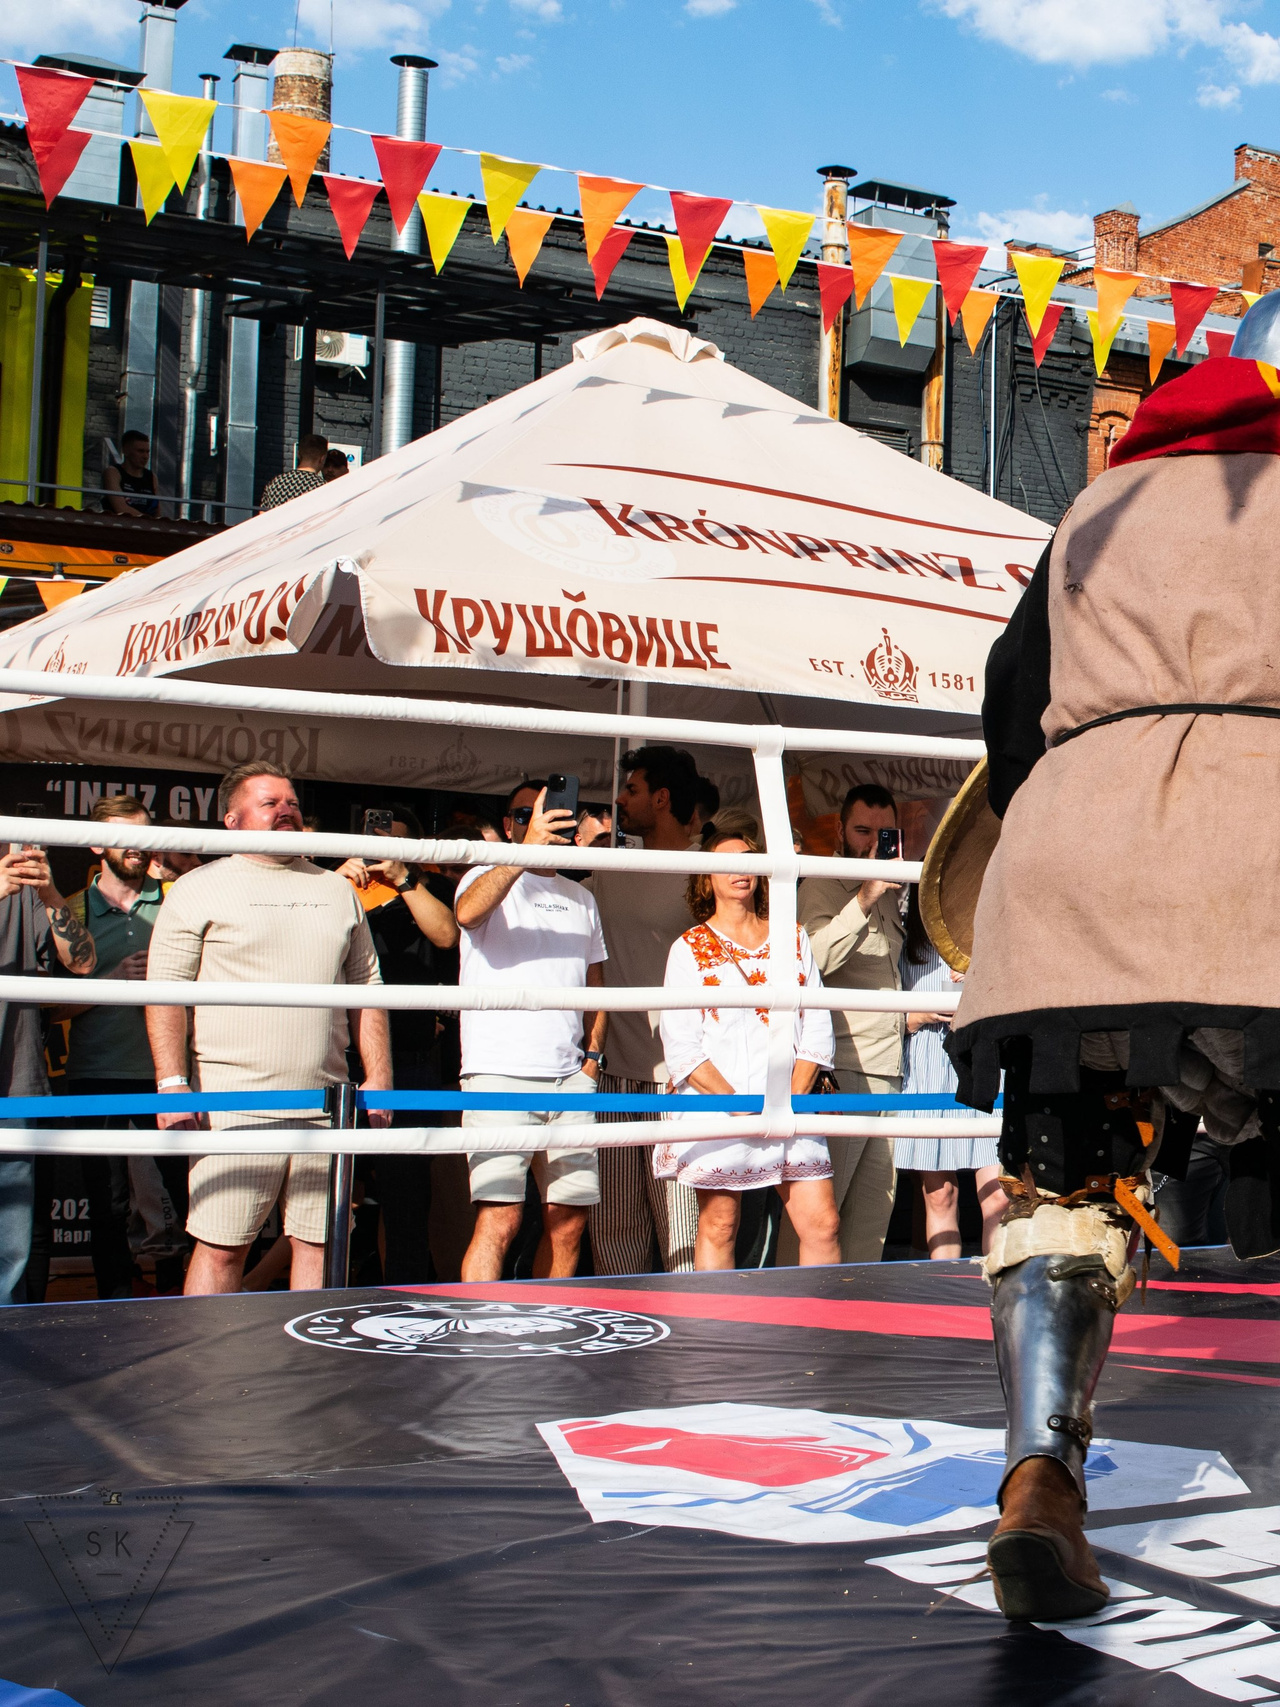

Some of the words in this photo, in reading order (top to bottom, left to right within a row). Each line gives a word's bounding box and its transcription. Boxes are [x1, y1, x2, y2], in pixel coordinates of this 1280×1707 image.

[578, 496, 1007, 593] KRÓNPRINZ
[808, 657, 855, 679] EST.
[928, 672, 976, 692] 1581
